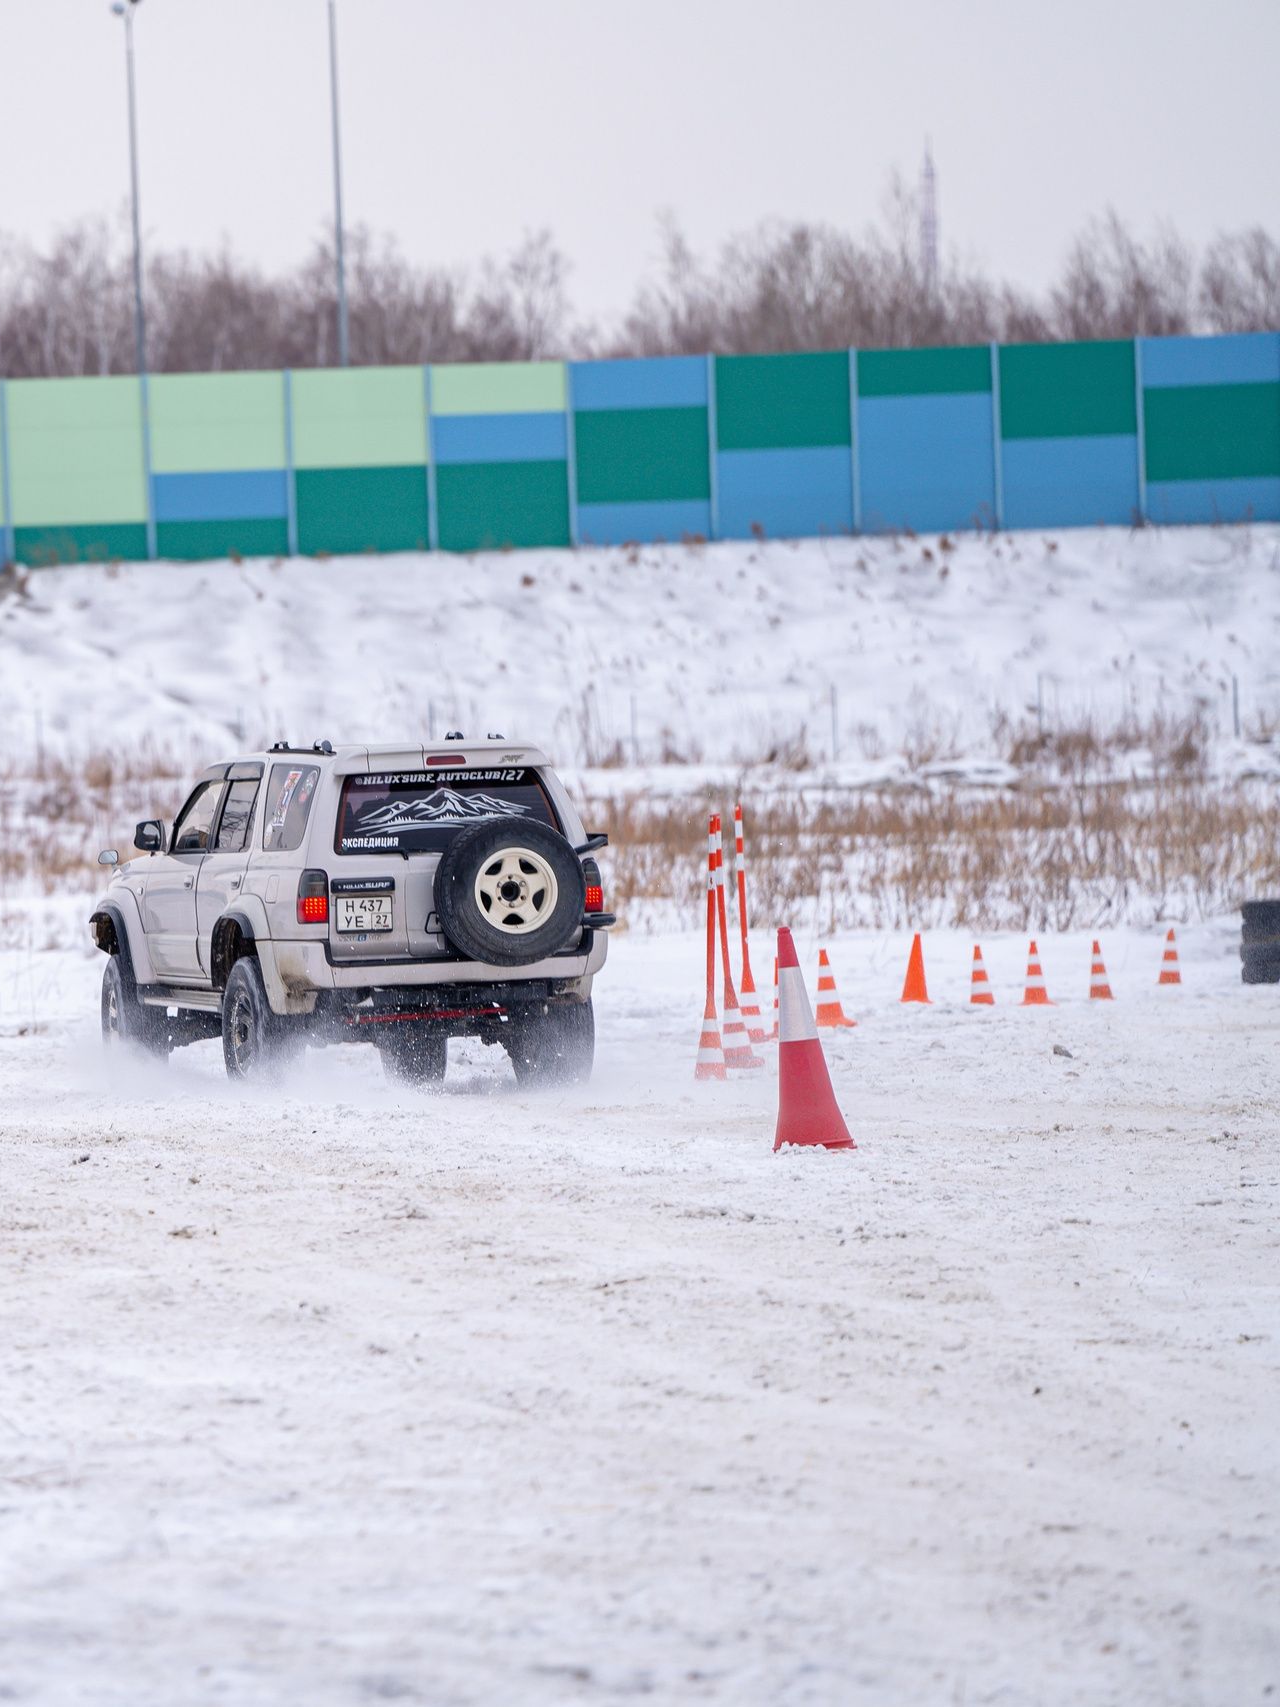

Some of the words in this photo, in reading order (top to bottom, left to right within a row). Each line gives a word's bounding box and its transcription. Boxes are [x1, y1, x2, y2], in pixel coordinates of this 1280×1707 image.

[341, 836, 399, 848] ЭКСПЕДИЦИЯ
[359, 899, 383, 912] 437
[375, 914, 388, 924] 27
